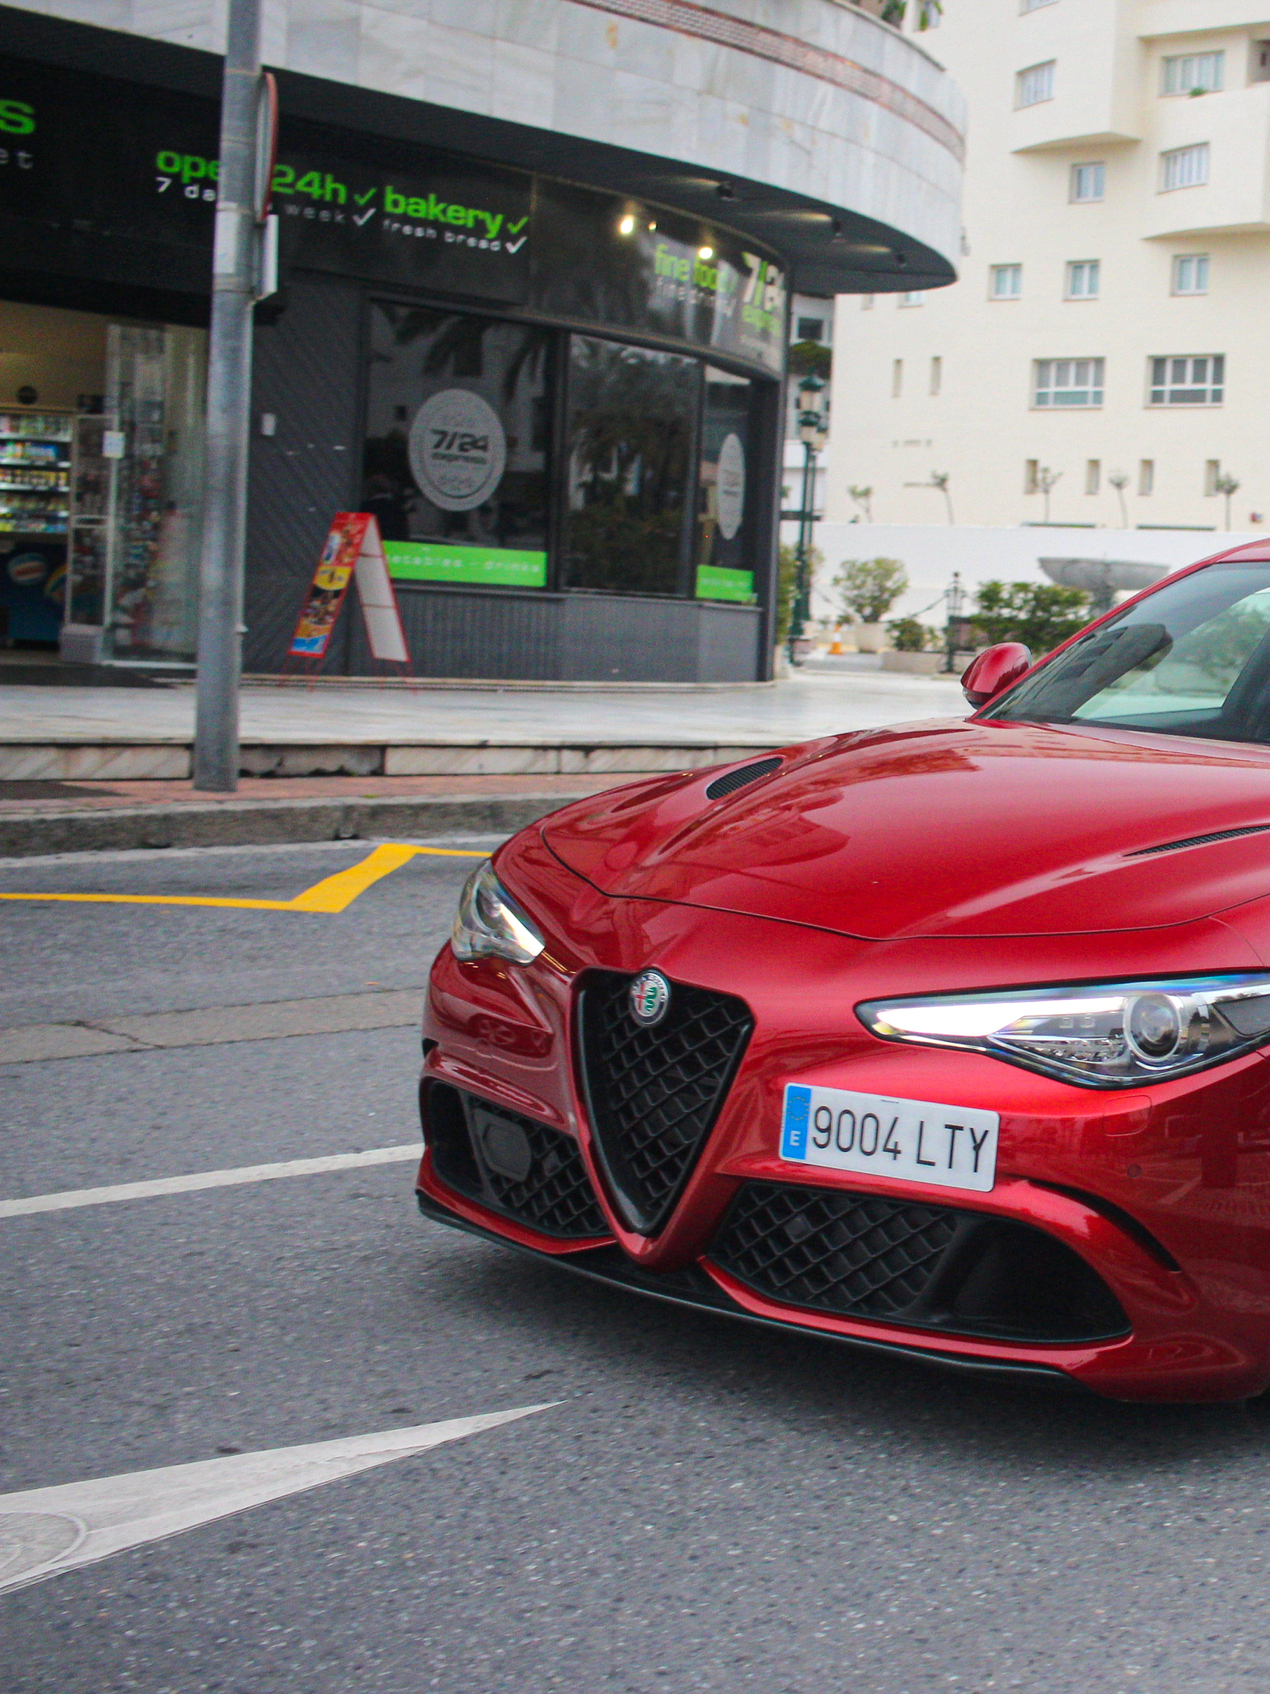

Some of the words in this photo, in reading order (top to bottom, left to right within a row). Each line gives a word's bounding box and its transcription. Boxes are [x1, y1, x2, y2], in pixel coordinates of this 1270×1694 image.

[271, 164, 348, 205] 24h
[383, 185, 504, 239] bakery
[430, 428, 489, 453] 7/24
[789, 1130, 800, 1146] E
[812, 1105, 902, 1161] 9004
[916, 1120, 989, 1173] LTY
